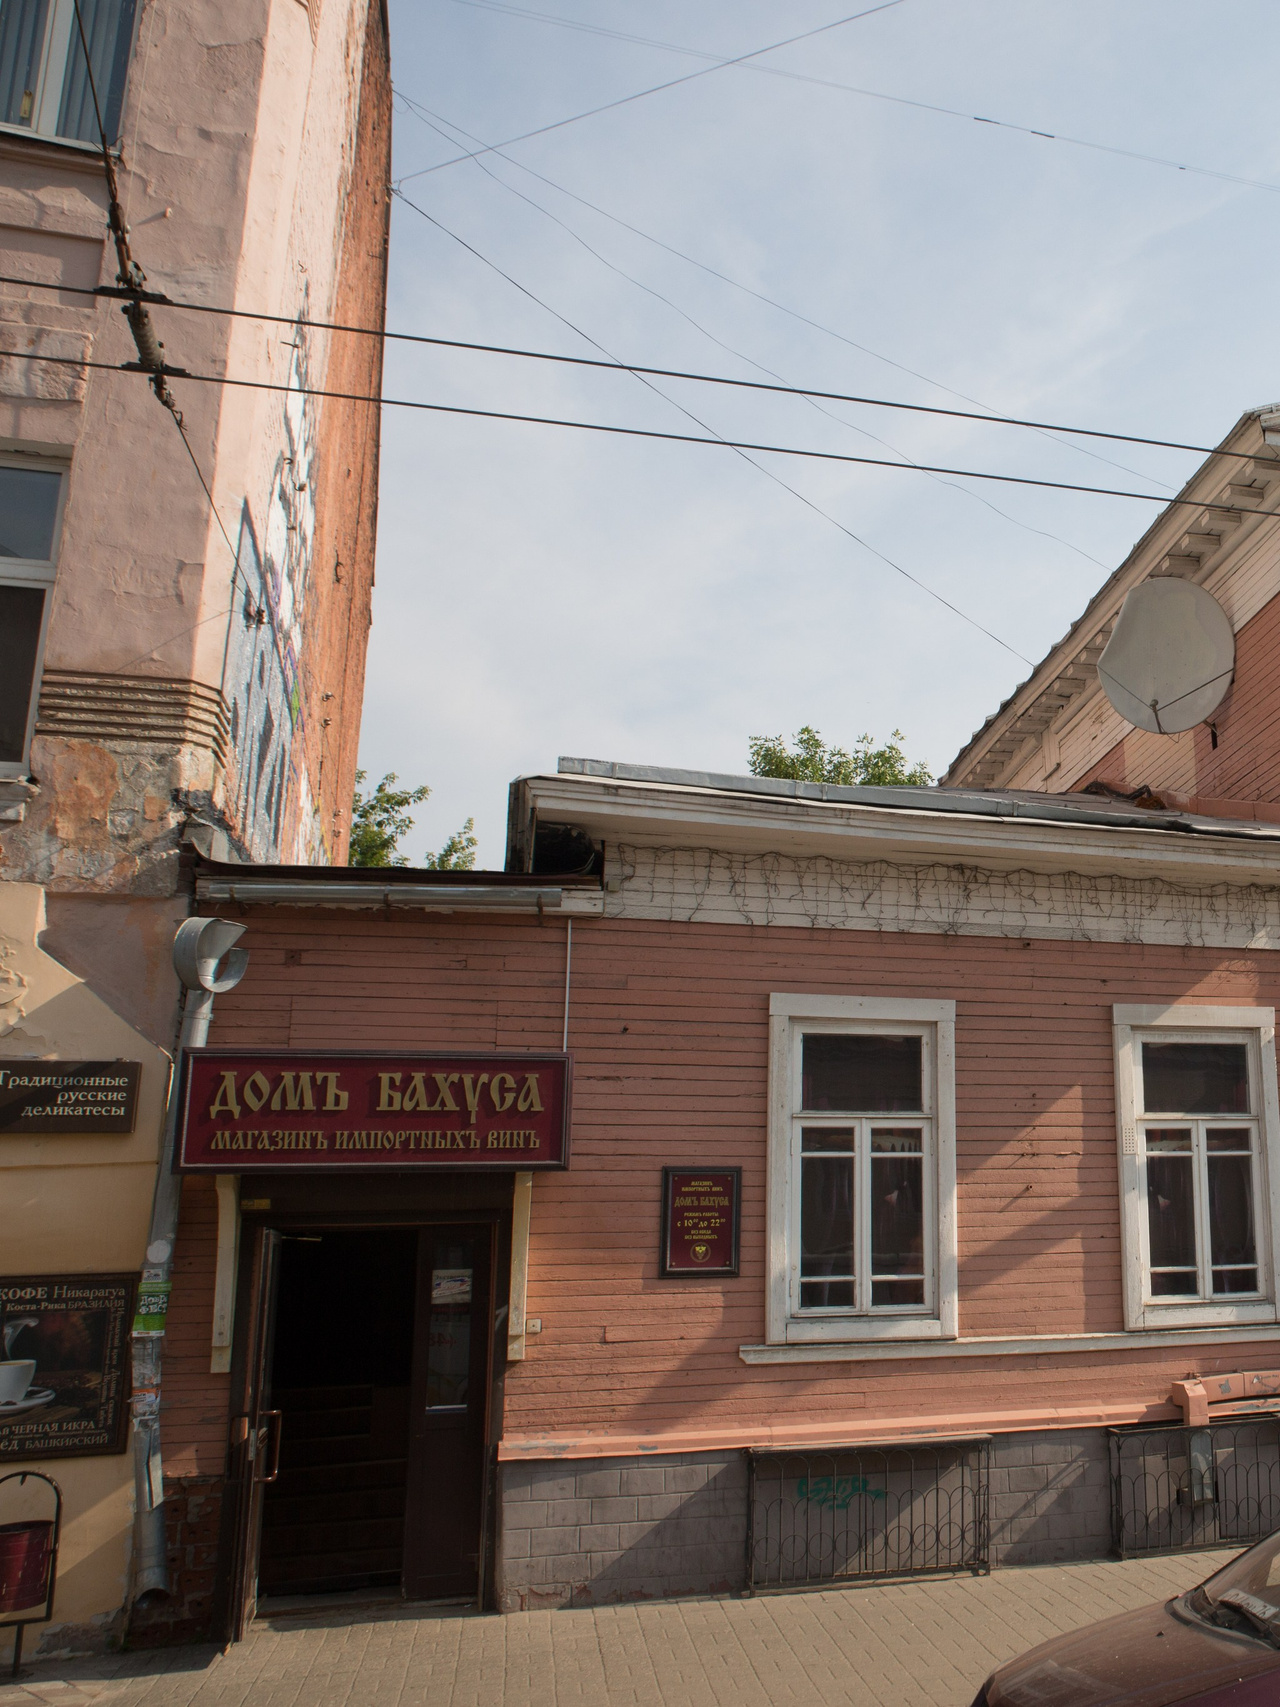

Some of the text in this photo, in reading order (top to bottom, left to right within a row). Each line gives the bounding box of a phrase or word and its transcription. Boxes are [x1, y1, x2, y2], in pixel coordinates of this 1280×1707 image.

[0, 1070, 129, 1089] Традиционные
[57, 1091, 127, 1104] русские
[209, 1070, 545, 1124] ДОМЪ БАХУСА
[21, 1106, 126, 1117] деликатесы
[210, 1130, 541, 1151] МАГАЗИНЪ ИМПОРТНЫХЪ ВИНЪ
[54, 1286, 126, 1299] Никарагуа
[6, 1299, 125, 1311] Коста-Рика БРАЗИЛИЯ
[12, 1422, 59, 1434] ЧЕРНАЯ
[63, 1420, 96, 1432] ИКРА
[25, 1433, 109, 1449] БАШКИРСКИЙ
